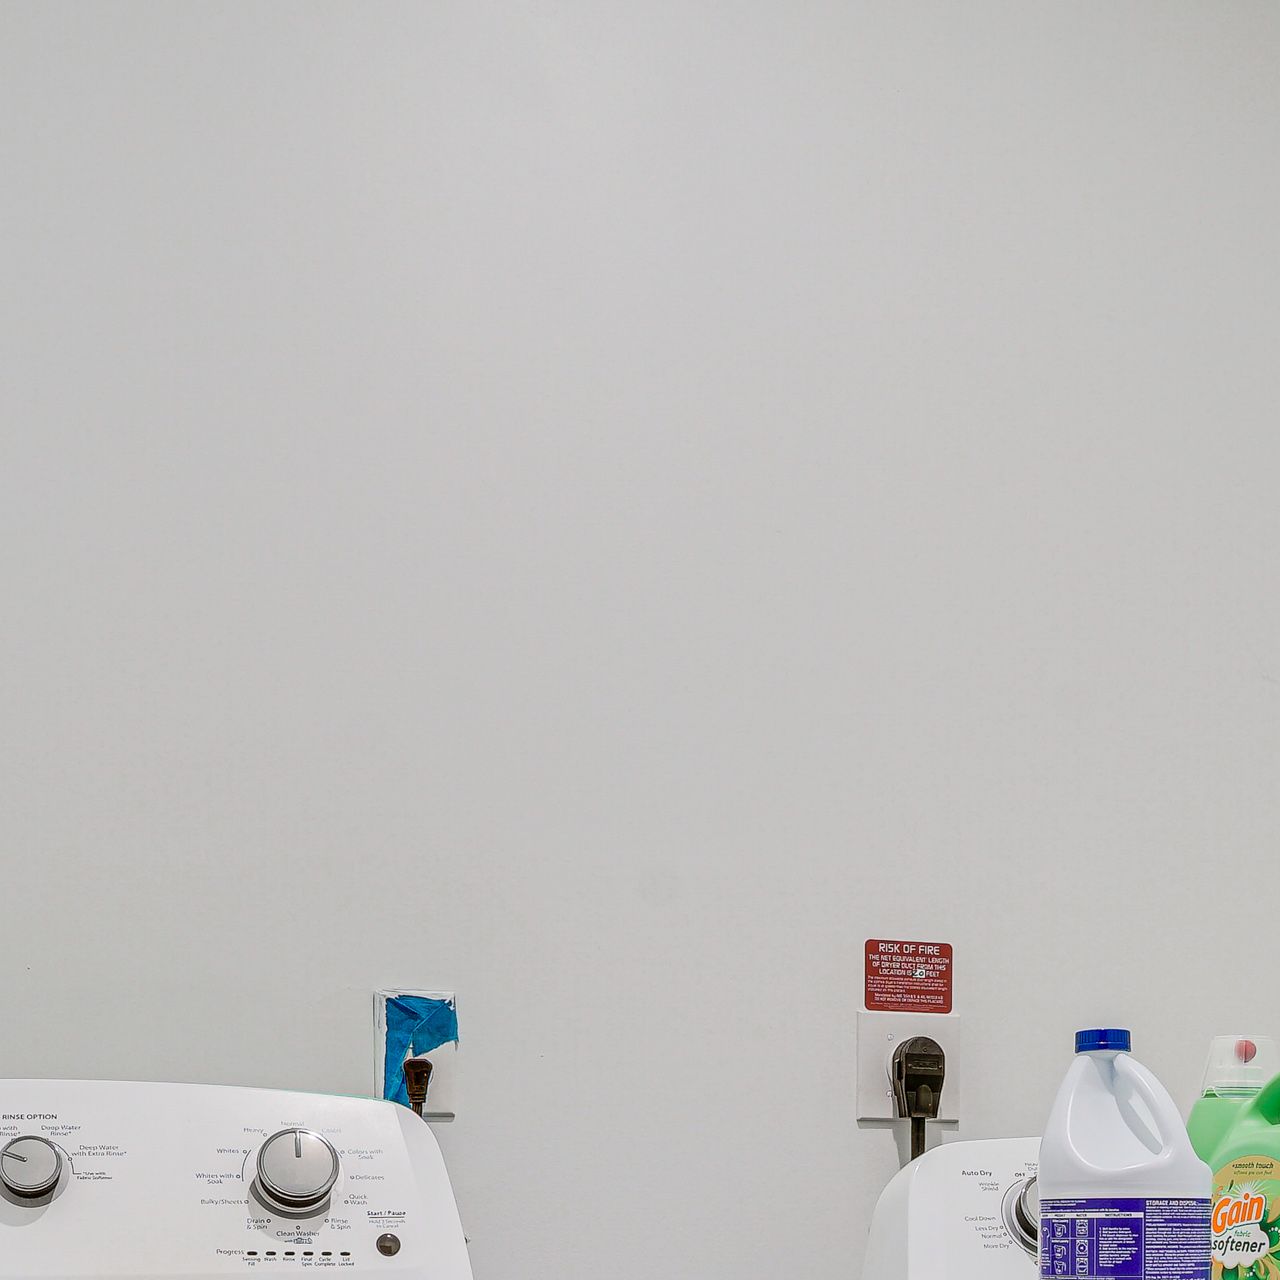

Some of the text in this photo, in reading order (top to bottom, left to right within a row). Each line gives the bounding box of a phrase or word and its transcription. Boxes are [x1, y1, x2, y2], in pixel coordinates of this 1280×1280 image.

[879, 943, 940, 955] RISK OF FIRE
[1212, 1193, 1264, 1233] Gain
[1212, 1236, 1265, 1256] softener
